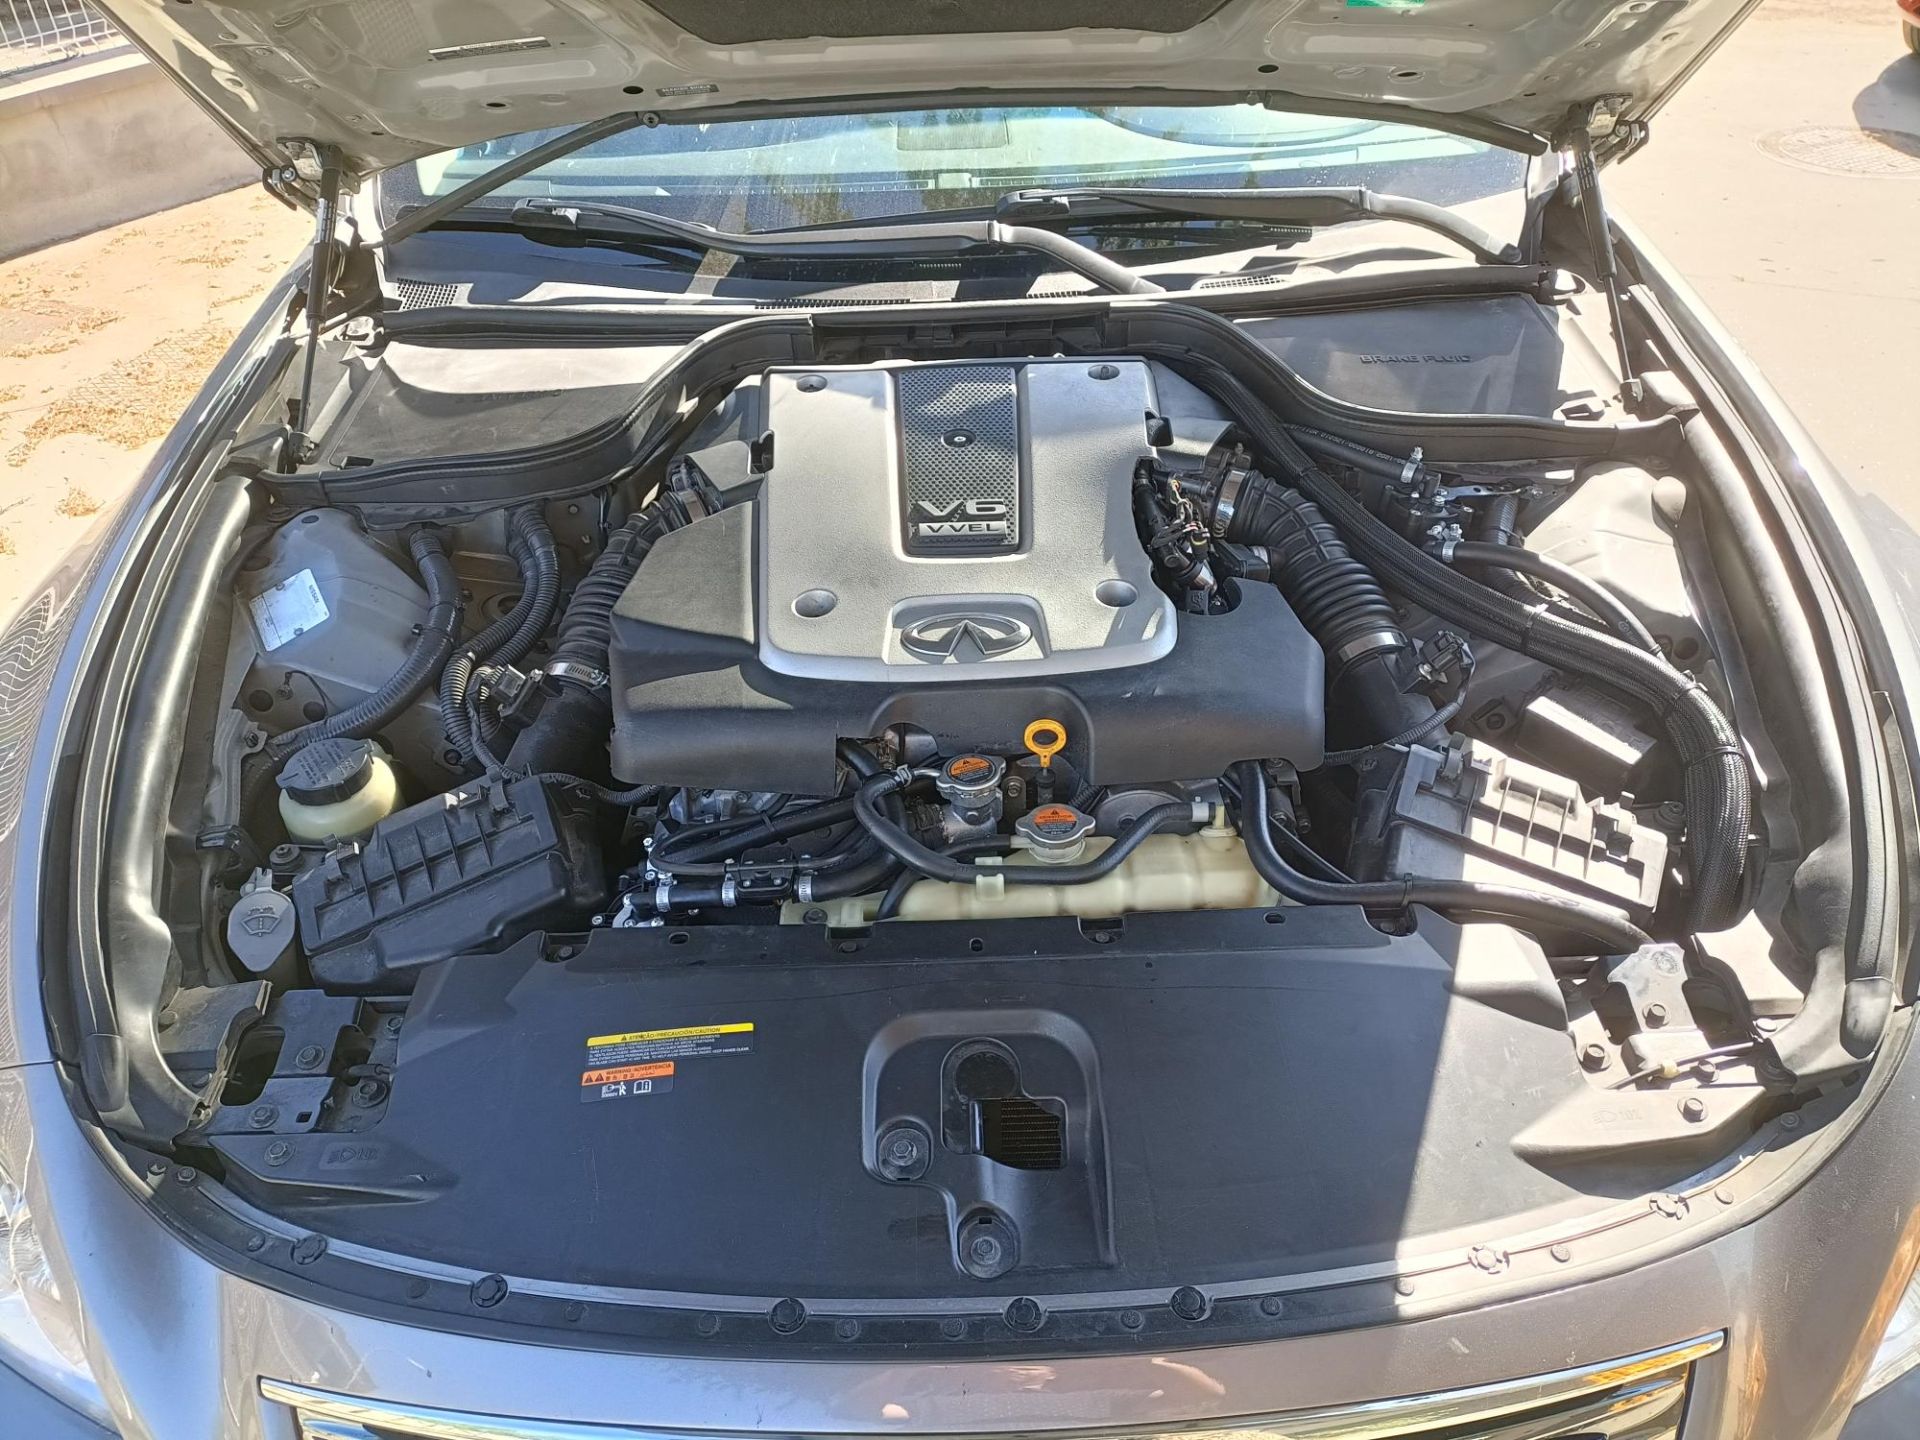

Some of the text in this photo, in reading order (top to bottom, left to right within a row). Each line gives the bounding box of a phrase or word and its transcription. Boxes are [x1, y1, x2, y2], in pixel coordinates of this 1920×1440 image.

[1360, 354, 1472, 364] BRAKE FLUID
[917, 499, 1006, 516] V6
[926, 522, 1000, 534] VVEL
